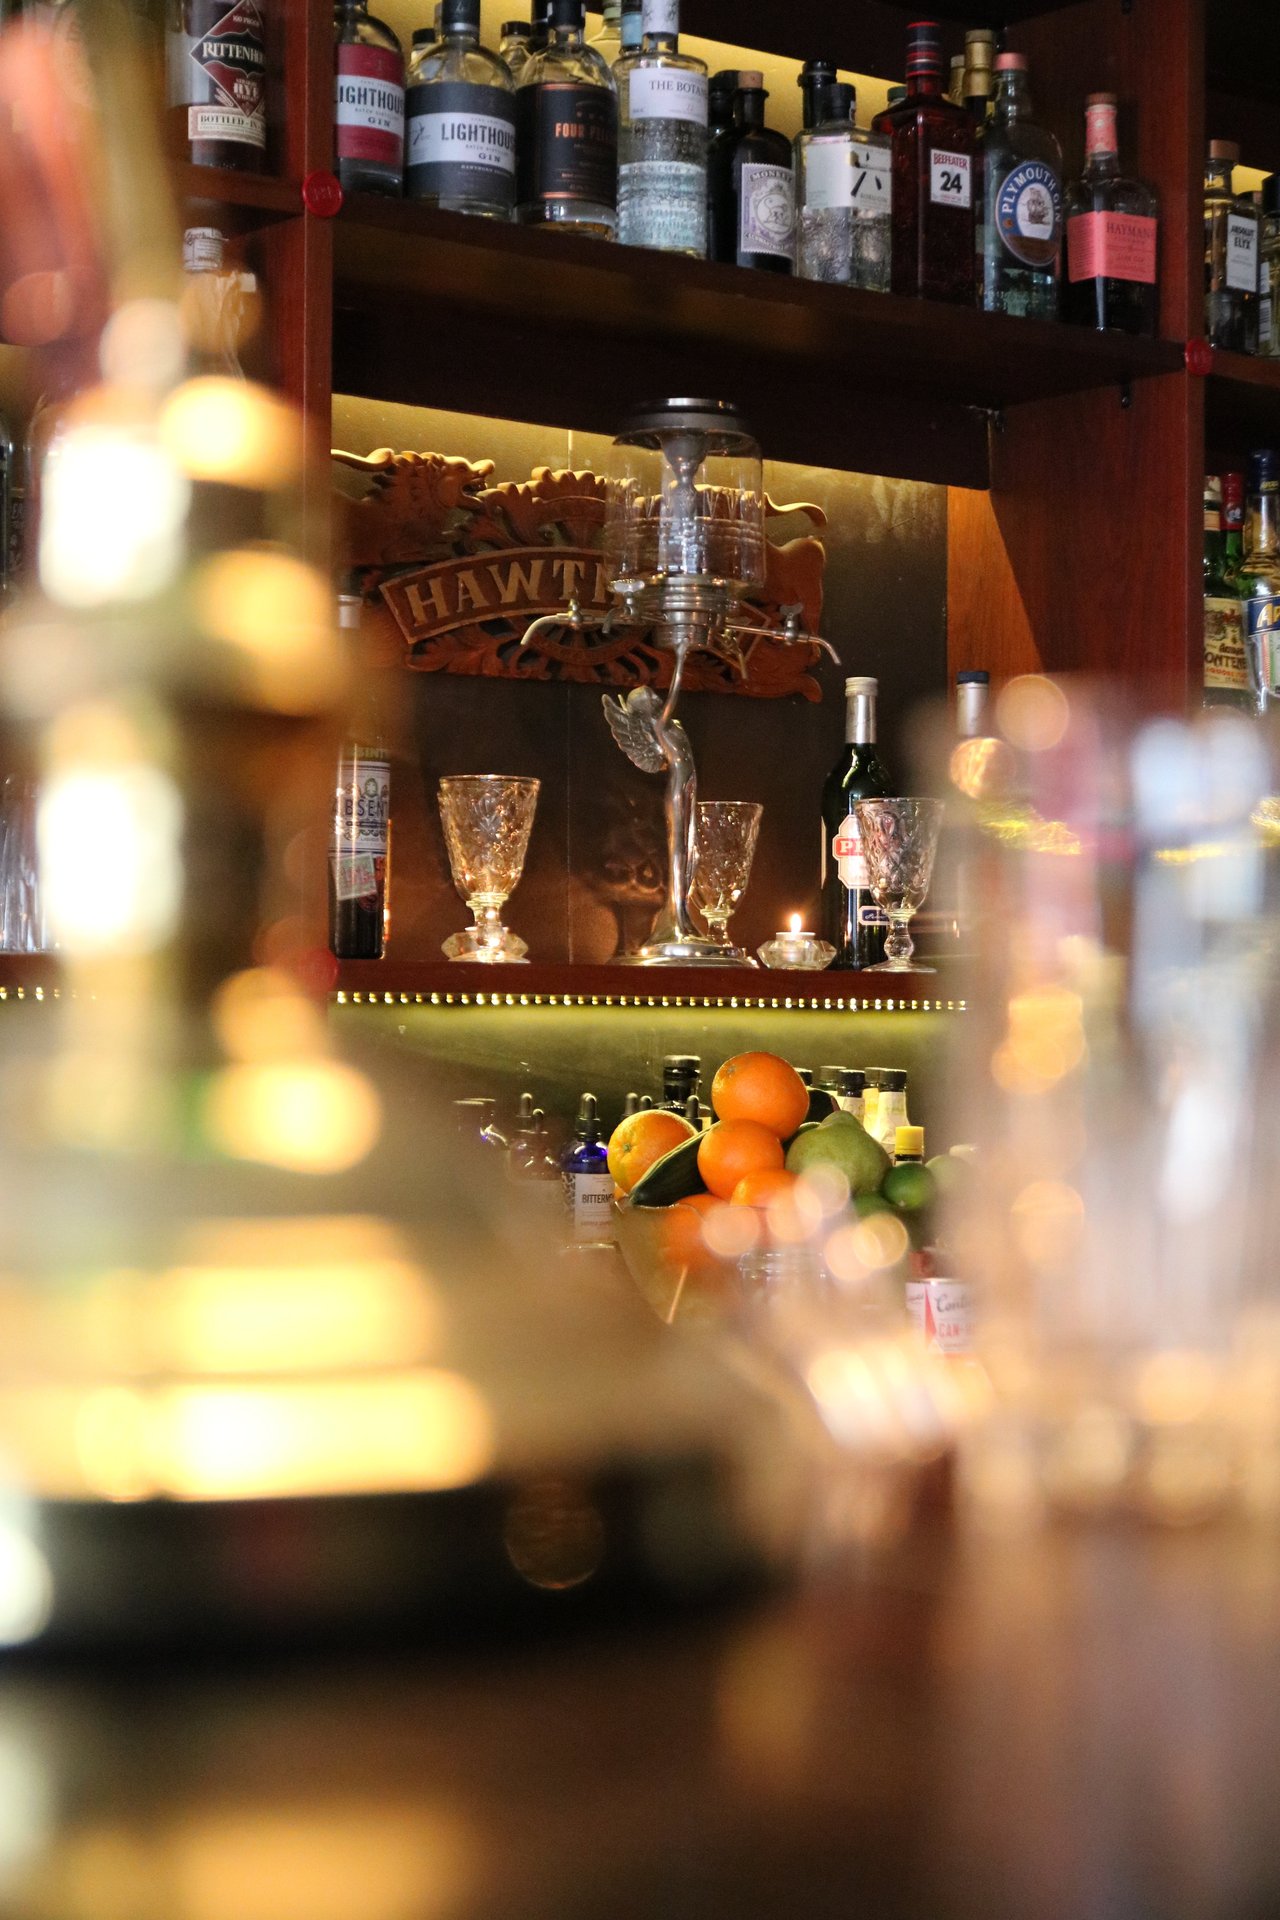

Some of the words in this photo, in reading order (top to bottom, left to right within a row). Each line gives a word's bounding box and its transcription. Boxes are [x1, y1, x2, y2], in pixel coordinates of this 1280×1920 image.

[649, 80, 674, 91] THE
[367, 116, 391, 127] GIN
[554, 122, 585, 138] FOUR
[478, 152, 501, 162] GIN
[933, 152, 968, 170] BEEFEATER
[940, 170, 963, 194] 24
[1001, 167, 1057, 213] PLYMOUTH
